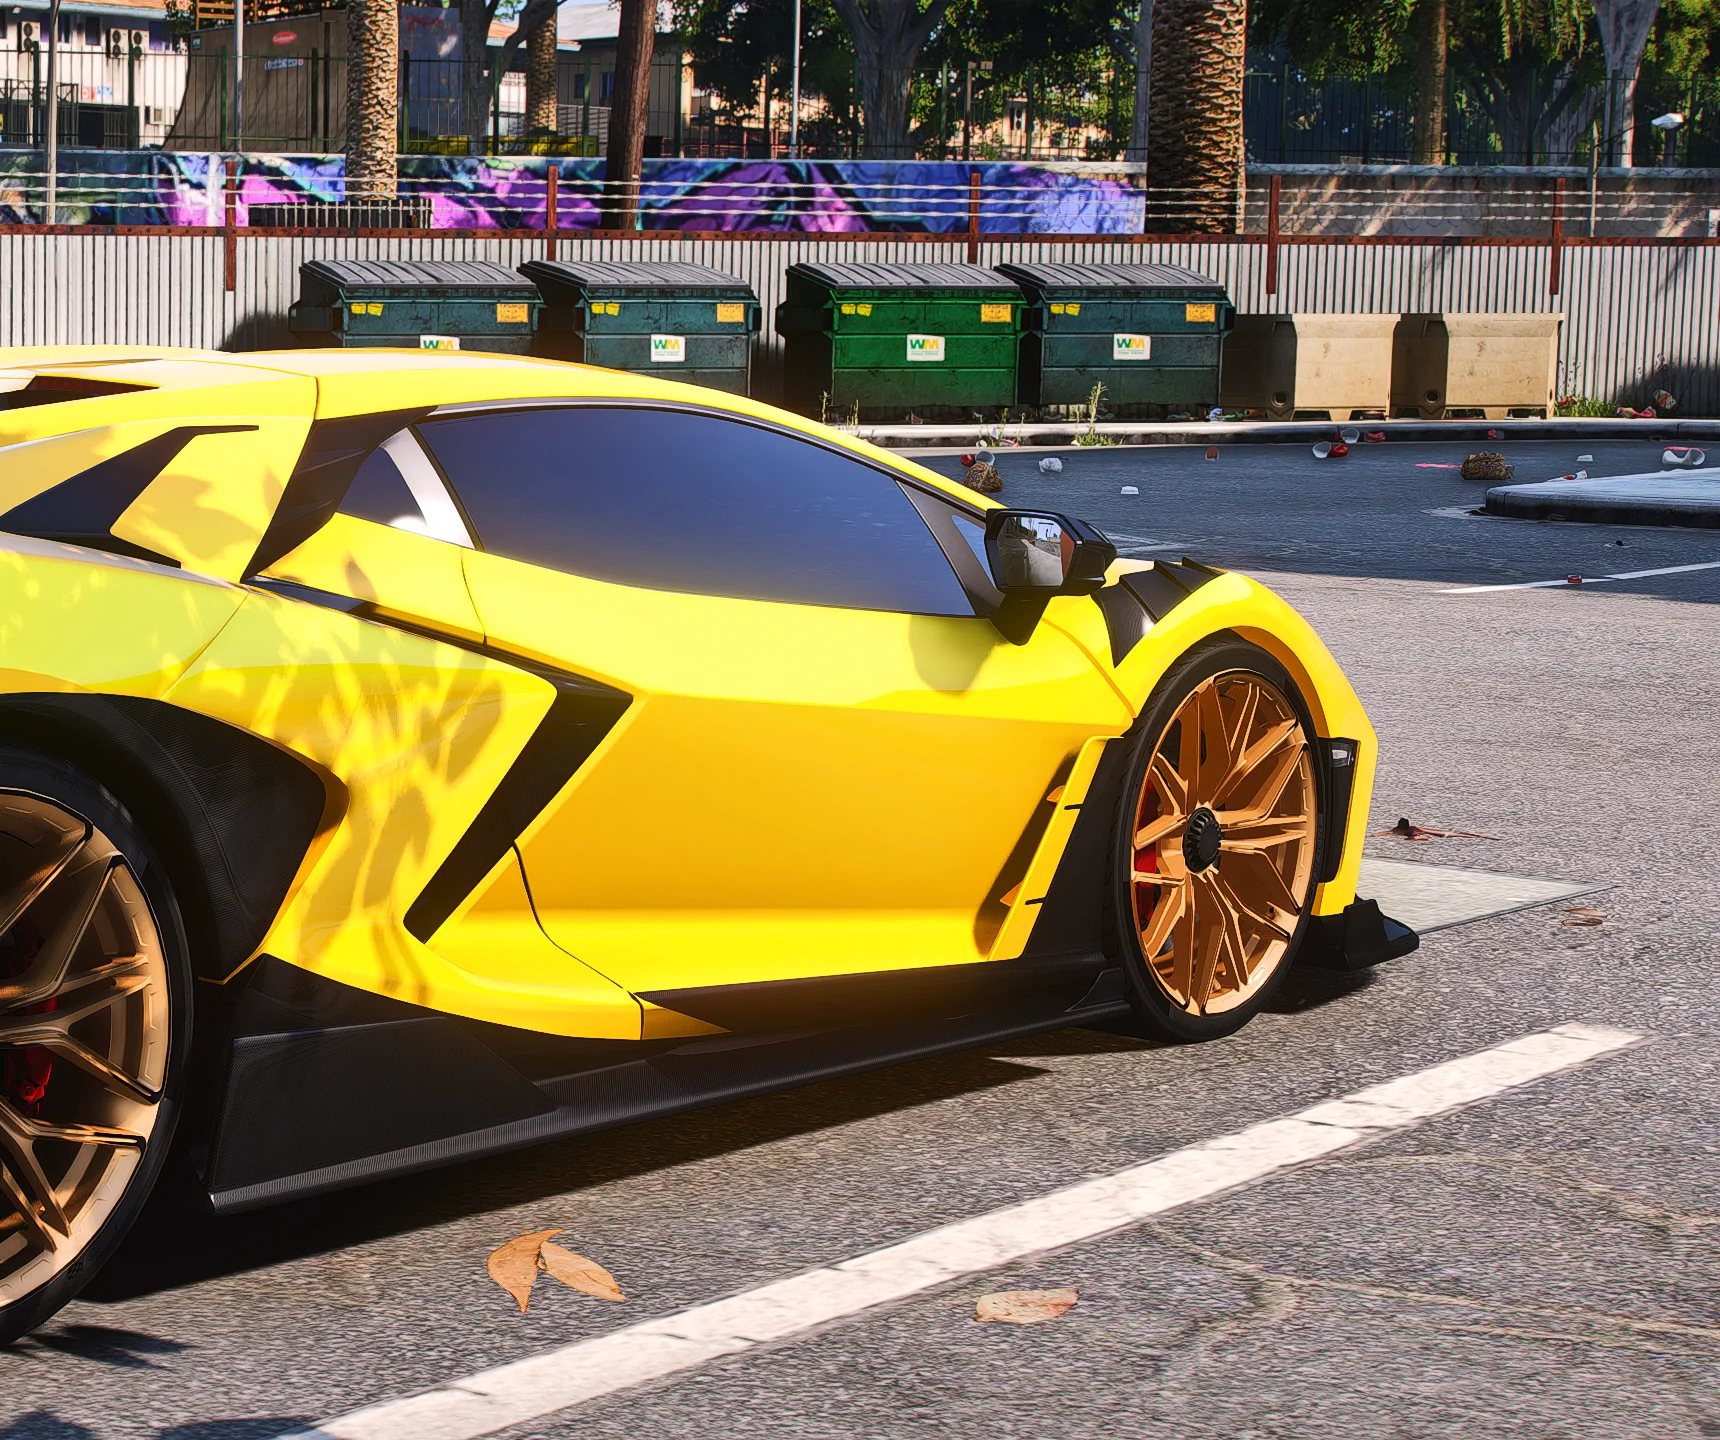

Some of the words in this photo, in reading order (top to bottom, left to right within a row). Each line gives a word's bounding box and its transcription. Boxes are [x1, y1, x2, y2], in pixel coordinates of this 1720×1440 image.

[423, 340, 454, 351] WM
[653, 339, 681, 350] WM
[910, 339, 940, 350] WM
[1116, 338, 1146, 349] WM
